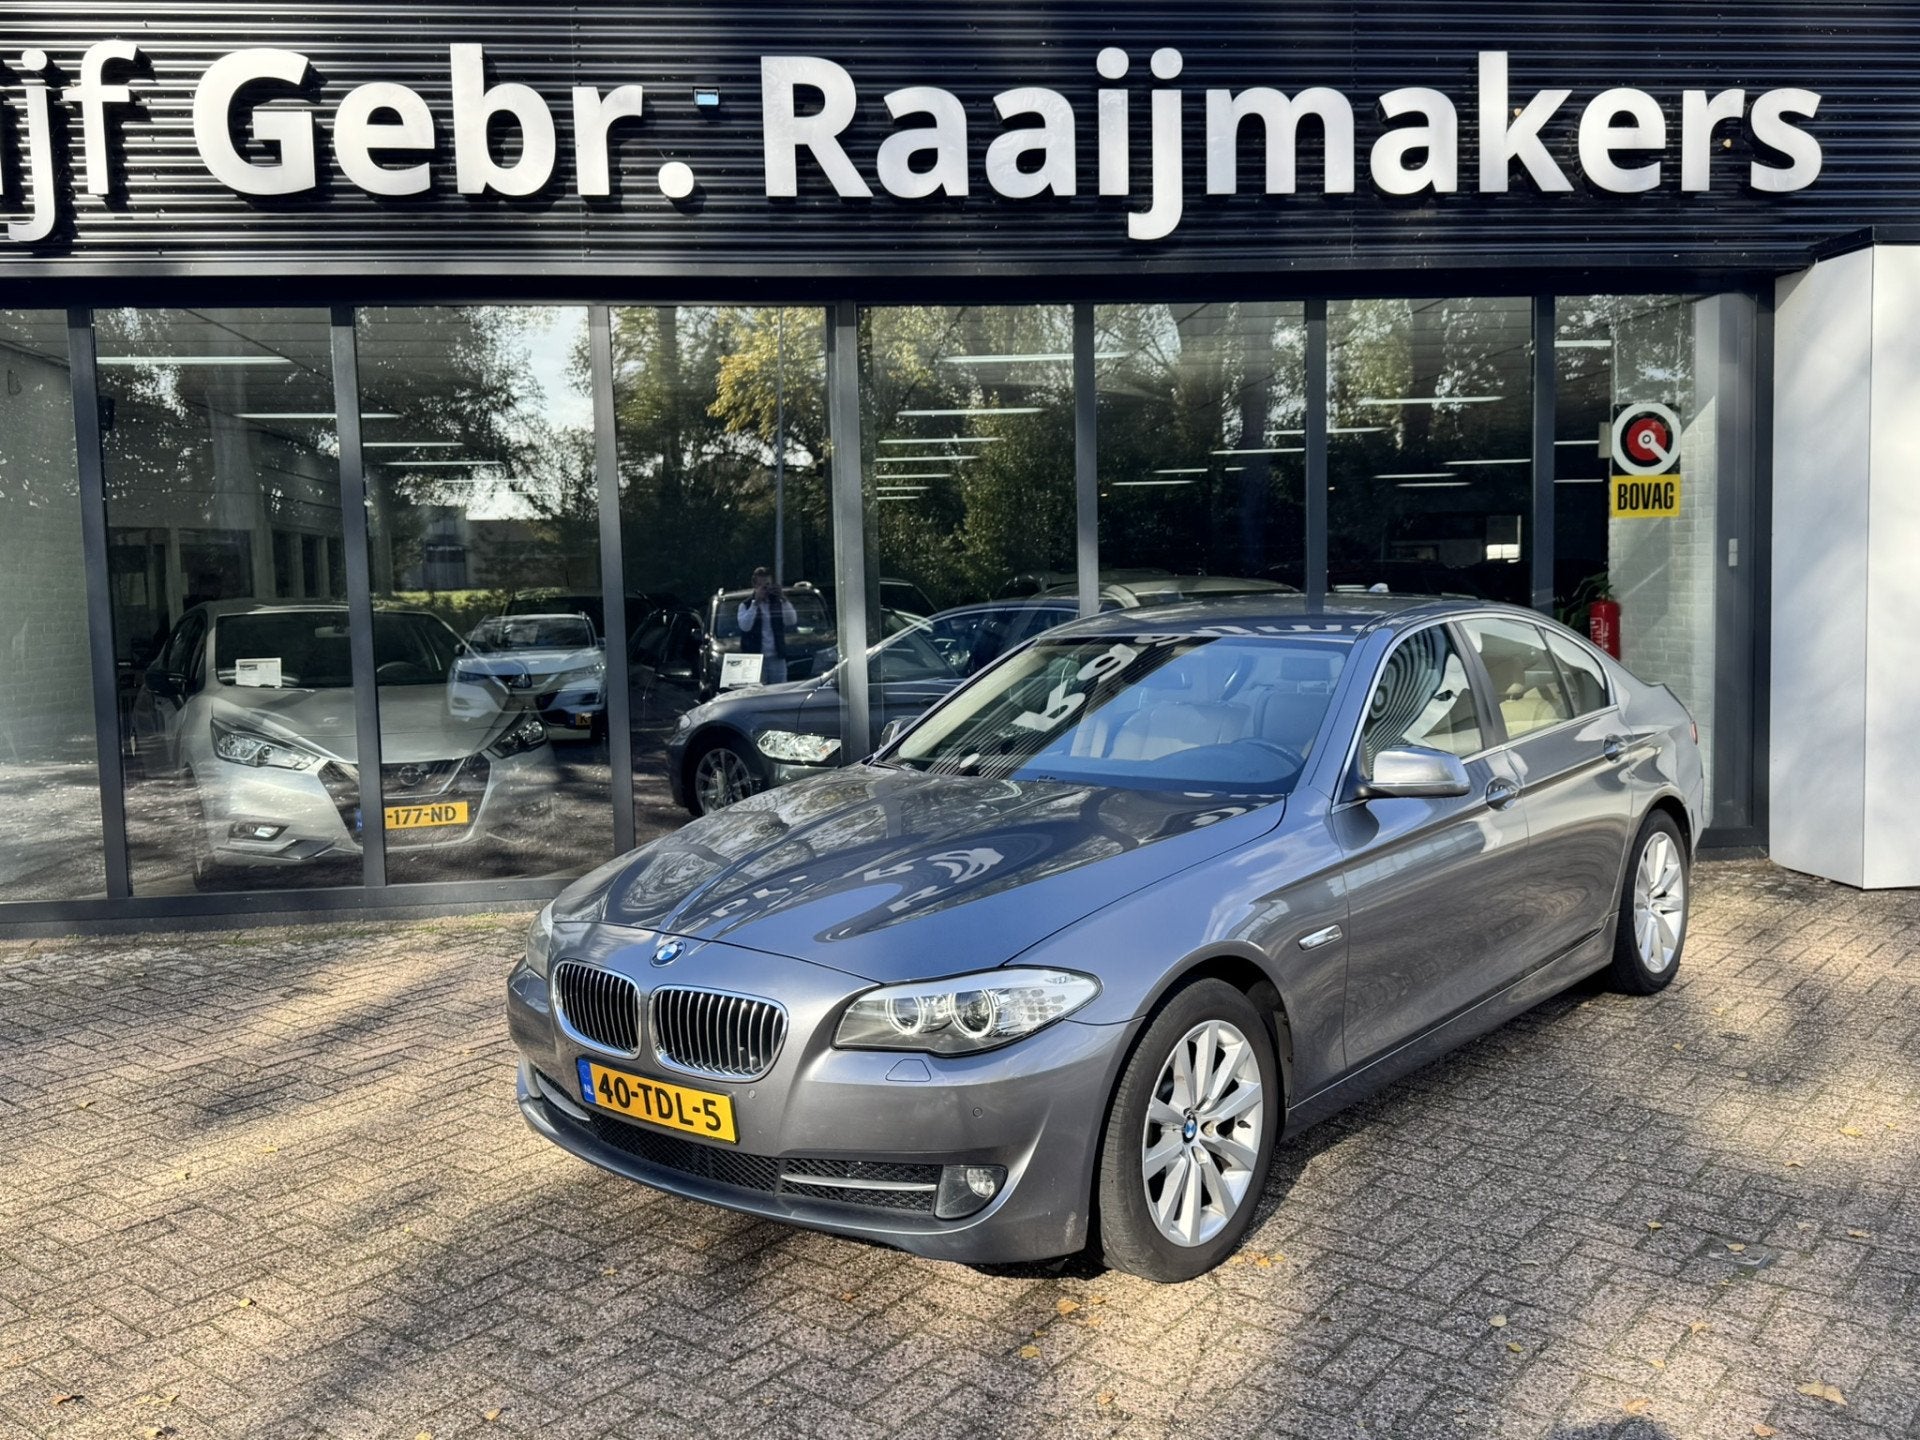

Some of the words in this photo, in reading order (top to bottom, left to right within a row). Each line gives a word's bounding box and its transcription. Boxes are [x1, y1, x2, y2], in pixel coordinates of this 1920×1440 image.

[0, 40, 137, 241] jf
[193, 43, 694, 198] Gebr.
[761, 47, 1823, 240] Raaijmakers
[1617, 482, 1674, 510] BOVAG
[386, 805, 457, 826] -177-ND
[598, 1072, 721, 1131] 40-TDL-5
